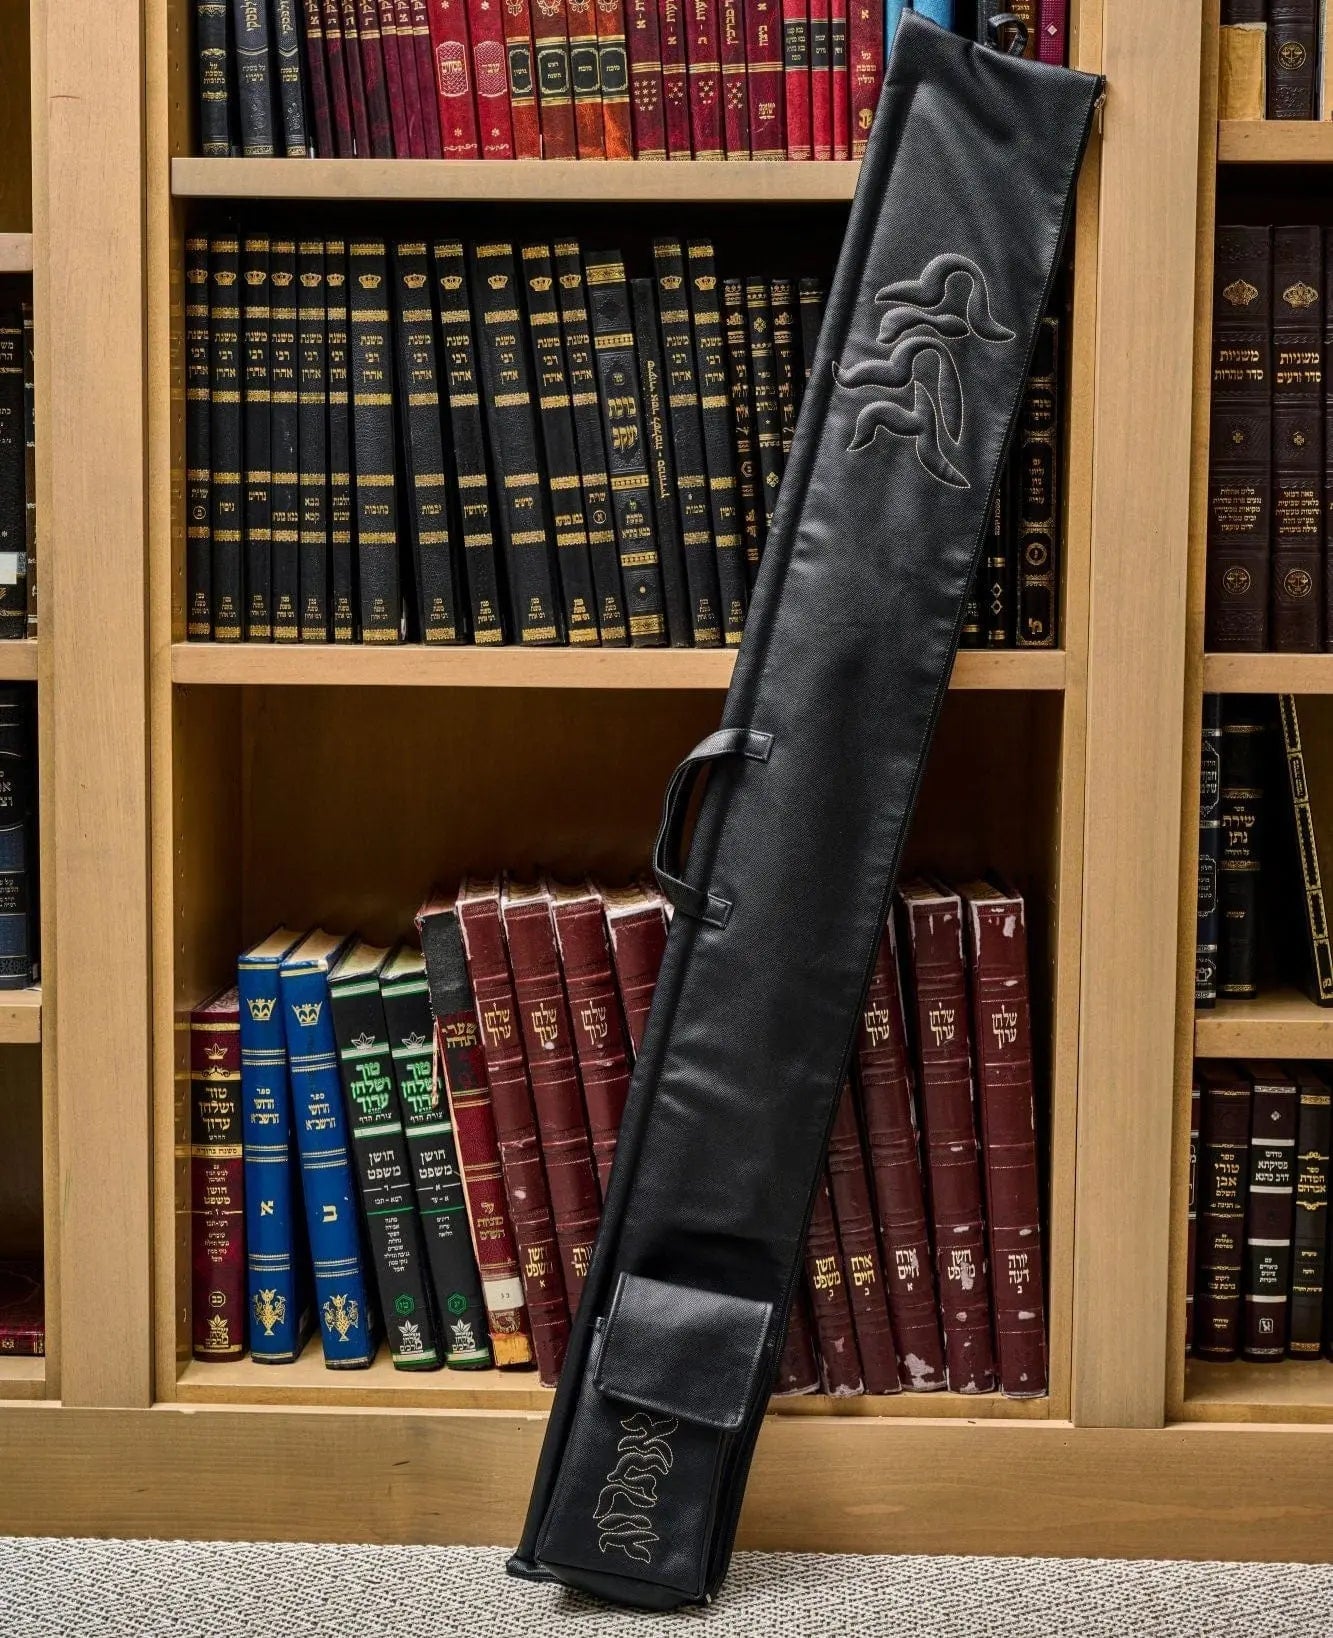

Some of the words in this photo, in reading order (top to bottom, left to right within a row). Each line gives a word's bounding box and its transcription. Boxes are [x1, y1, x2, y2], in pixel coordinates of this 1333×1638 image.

[758, 25, 769, 46] ביצה
[215, 333, 238, 343] משנת
[246, 331, 268, 342] משנת
[272, 334, 294, 343] משנת
[300, 334, 323, 344] משנת
[360, 336, 383, 346] משנת
[408, 335, 431, 346] משנת
[446, 336, 470, 347] משנת
[495, 335, 516, 347] משנת
[567, 334, 590, 346] משנת
[665, 336, 688, 347] משנת
[537, 338, 560, 349] משנת
[701, 338, 723, 349] משנת
[219, 351, 233, 361] רבי
[249, 350, 263, 360] רבי
[275, 351, 290, 361] רבי
[304, 352, 319, 361] רבי
[365, 353, 379, 363] רבי
[413, 352, 428, 363] רבי
[452, 353, 467, 364] רבי
[500, 353, 514, 364] רבי
[543, 355, 559, 366] רבי
[573, 352, 588, 363] רבי
[672, 354, 687, 364] רבי
[707, 354, 721, 365] רבי
[1220, 350, 1260, 362] משניות
[1280, 352, 1320, 365] משניות
[216, 368, 236, 381] אהרן
[247, 366, 266, 380] אהרן
[273, 368, 293, 381] אהרן
[302, 369, 321, 383] אהרן
[363, 371, 383, 383] אהרן
[411, 371, 432, 384] אהרן
[451, 371, 471, 386] אהרן
[500, 371, 519, 385] אהרן
[572, 371, 592, 384] אהרן
[671, 371, 692, 386] אהרן
[705, 372, 725, 386] אהרן
[1214, 369, 1243, 381] טהרות
[1245, 369, 1264, 380] סדר
[1277, 372, 1302, 384] זרעים
[1304, 372, 1322, 382] סדר
[543, 373, 563, 387] אהרן
[650, 394, 661, 415] אשר
[364, 505, 389, 515] כתובות
[1221, 815, 1256, 828] שירת
[1228, 831, 1249, 847] נתן
[485, 1001, 511, 1032] שלחן
[531, 1002, 558, 1032] שלחן
[581, 1000, 607, 1030] שלחן
[864, 1002, 889, 1031] שלחן
[929, 1001, 955, 1031] שלחן
[991, 1004, 1018, 1033] שלחן
[441, 1022, 477, 1036] שערי
[487, 1024, 512, 1047] ערוך
[534, 1024, 559, 1047] ערוך
[584, 1022, 608, 1046] ערוך
[930, 1024, 955, 1047] ערוך
[866, 1024, 890, 1048] ערוך
[992, 1028, 1017, 1050] ערוך
[206, 1086, 228, 1100] טור
[256, 1087, 271, 1095] ספר
[351, 1076, 392, 1099] ושלחן
[310, 1093, 325, 1101] ספר
[356, 1092, 389, 1113] ערוך
[198, 1101, 235, 1118] ושלחן
[426, 1111, 443, 1120] צורת
[359, 1115, 374, 1123] הדף
[375, 1112, 392, 1121] צורת
[410, 1114, 424, 1123] הדף
[202, 1117, 231, 1133] ערוך
[368, 1149, 395, 1167] חושן
[419, 1148, 446, 1166] חושן
[367, 1165, 402, 1181] משפט
[418, 1164, 452, 1180] משפט
[1214, 1164, 1241, 1175] טורי
[1257, 1161, 1289, 1175] פסיקתא
[1215, 1175, 1238, 1188] אבן
[1255, 1174, 1274, 1185] כהנא
[1275, 1174, 1291, 1185] דרב
[206, 1186, 228, 1200] חושן
[1298, 1184, 1328, 1194] אברהם
[203, 1196, 231, 1205] משפט
[260, 1200, 274, 1217] א
[322, 1205, 338, 1223] ב
[851, 1254, 873, 1271] ארח
[951, 1249, 972, 1268] חשן
[1008, 1253, 1028, 1269] יורה
[816, 1256, 836, 1277] חשן
[813, 1271, 841, 1289] משפט
[853, 1269, 876, 1286] חיים
[1008, 1268, 1029, 1284] דעה
[864, 1287, 870, 1296] ב
[907, 1283, 913, 1291] א
[1017, 1286, 1023, 1294] ב
